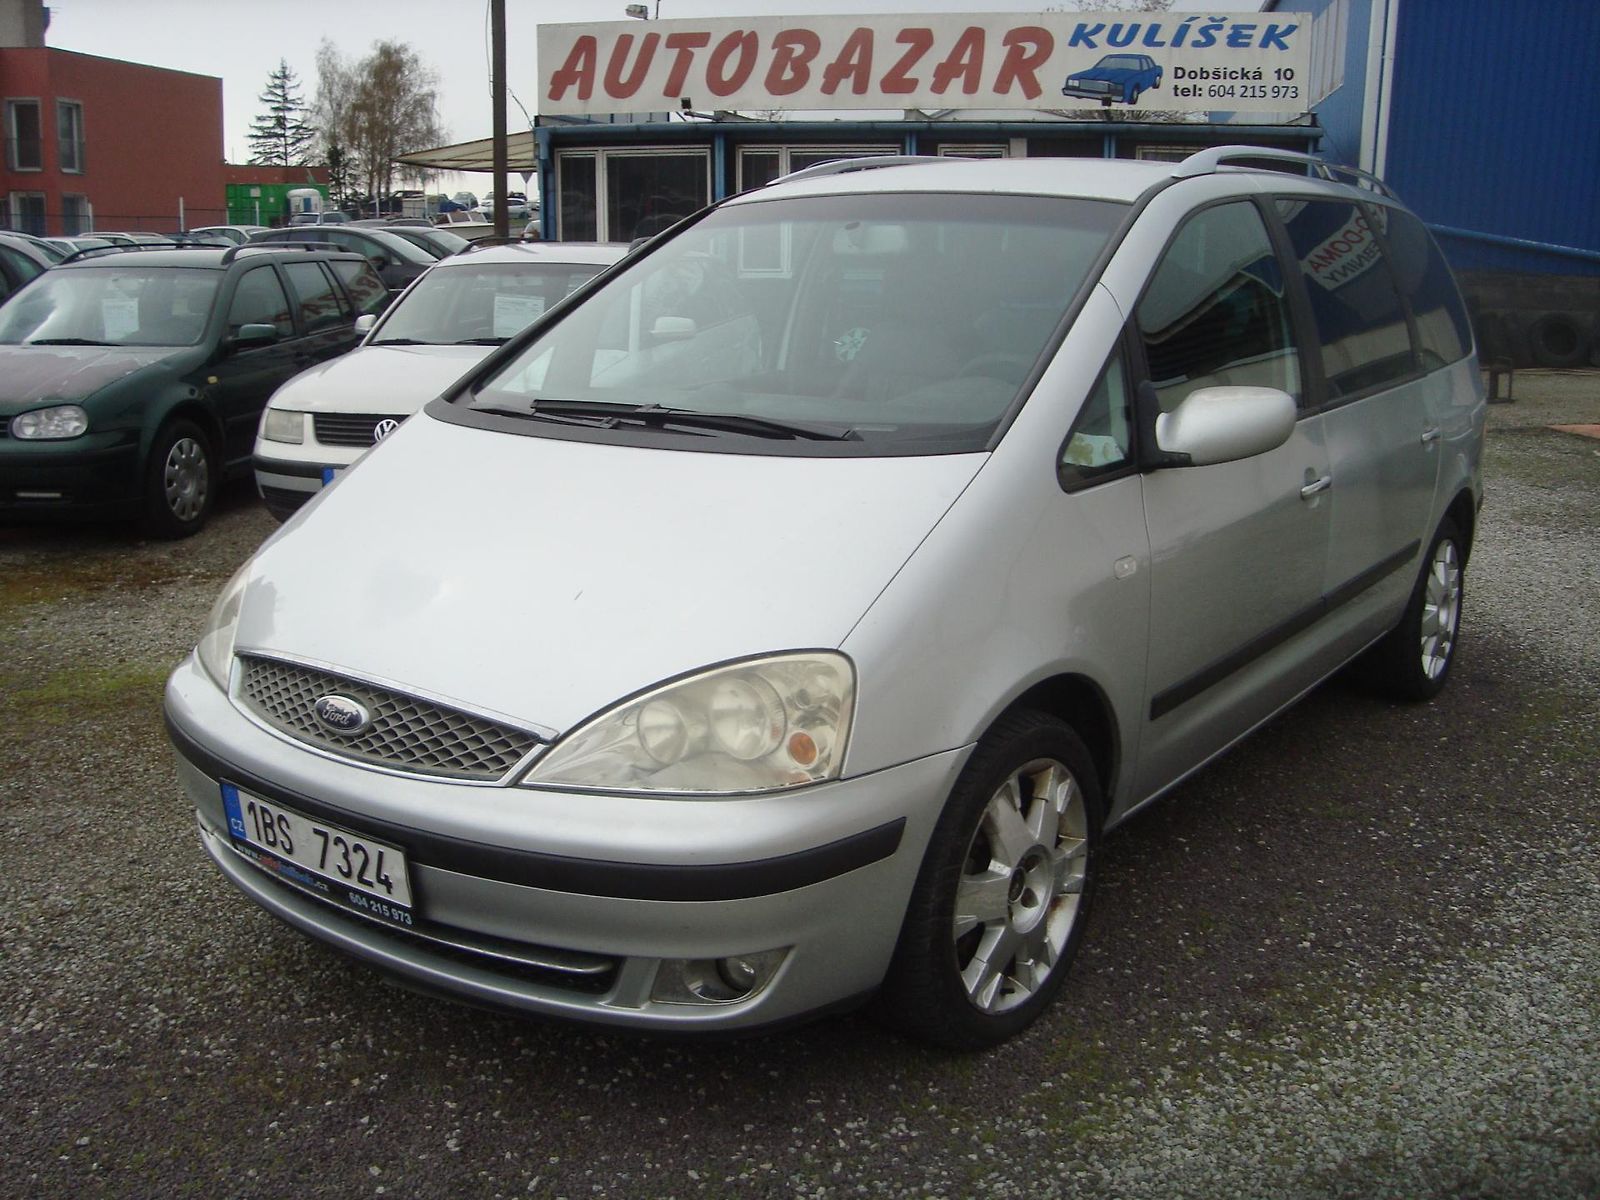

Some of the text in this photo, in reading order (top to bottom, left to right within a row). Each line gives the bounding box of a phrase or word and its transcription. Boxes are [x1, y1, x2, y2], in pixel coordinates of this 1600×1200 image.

[1068, 17, 1298, 50] KULÍŠEK
[547, 26, 1054, 101] AUTOBAZAR
[1174, 66, 1295, 81] Dobšická 10
[1173, 84, 1299, 99] tel: 604 215 973
[321, 702, 351, 725] Ford
[230, 816, 244, 832] CZ
[247, 800, 294, 855] 1BS
[312, 827, 393, 894] 7324
[349, 892, 413, 925] 604 215 973
